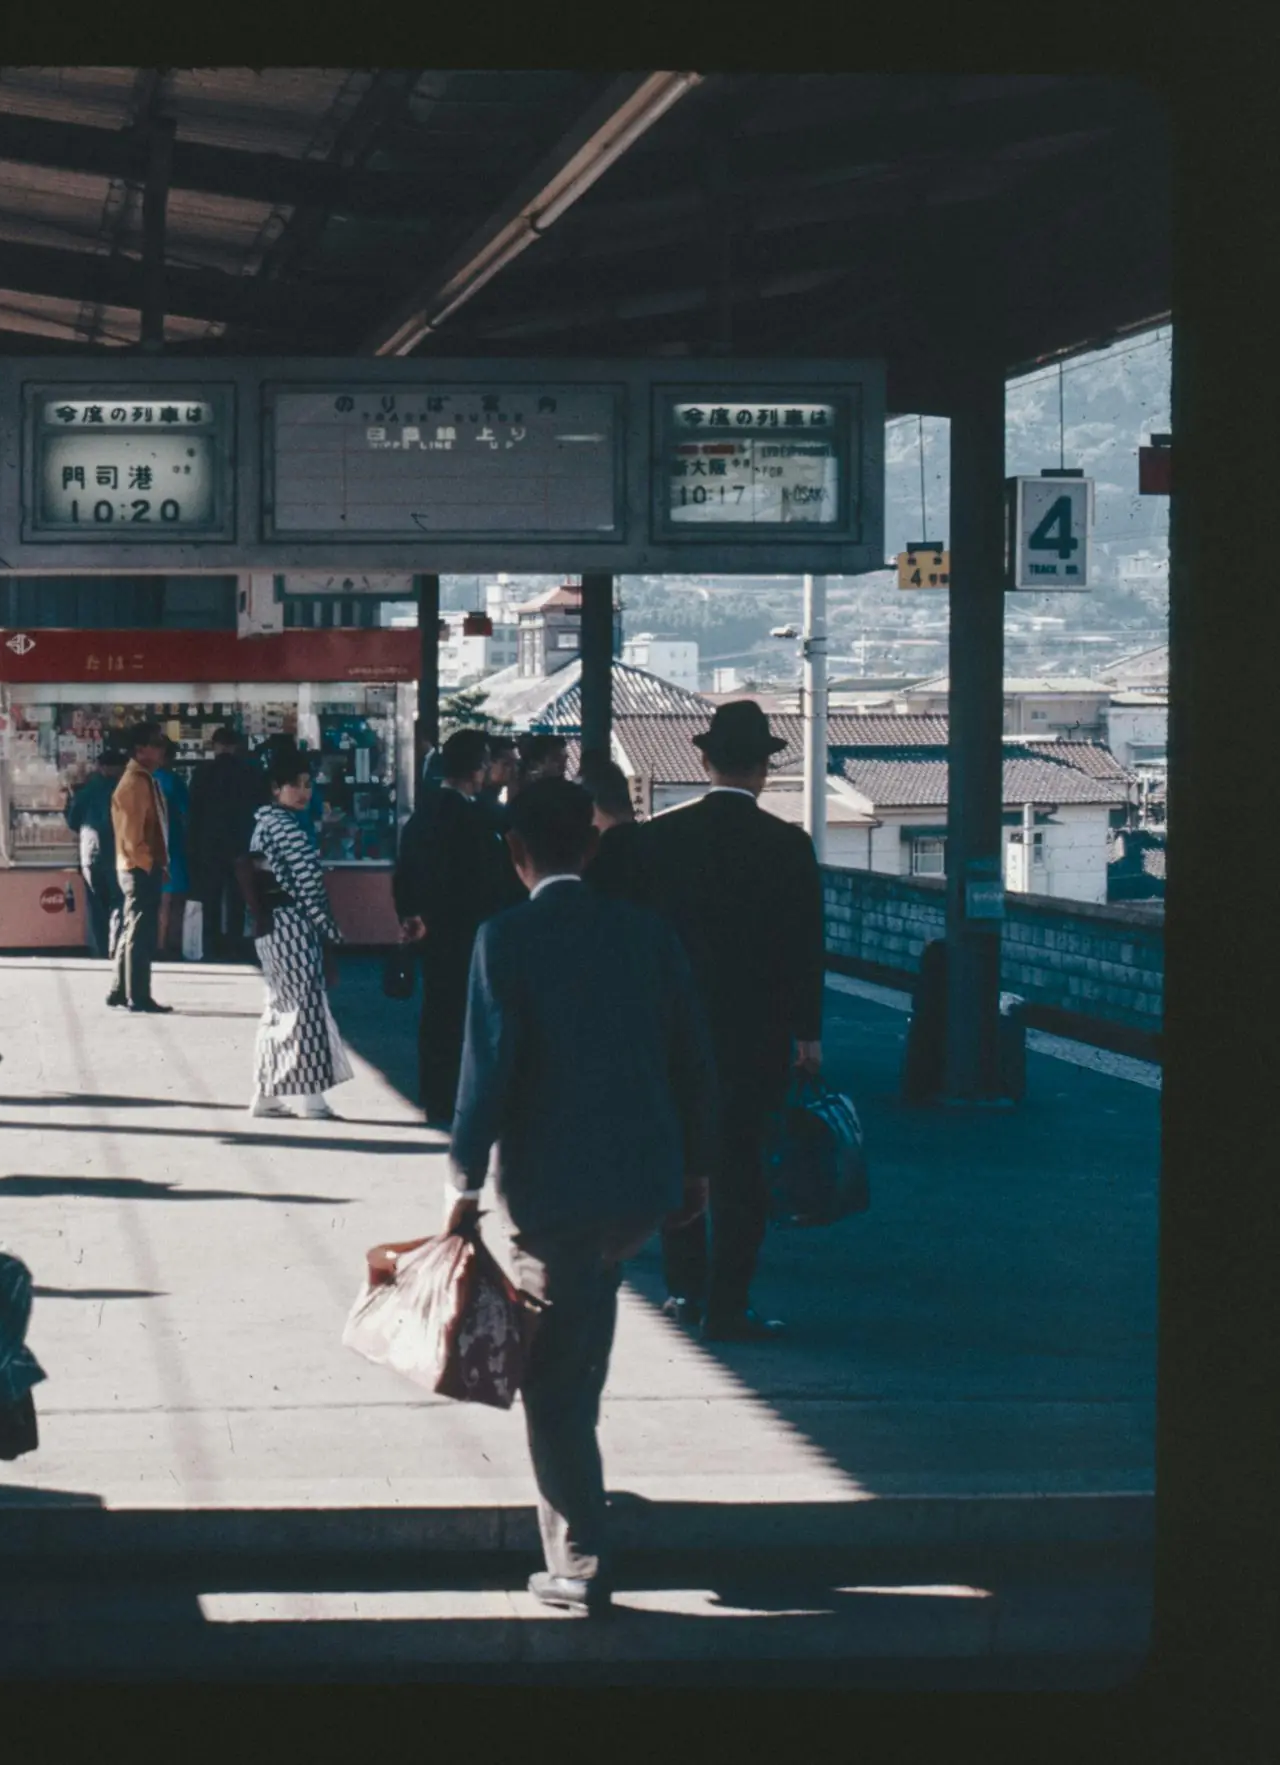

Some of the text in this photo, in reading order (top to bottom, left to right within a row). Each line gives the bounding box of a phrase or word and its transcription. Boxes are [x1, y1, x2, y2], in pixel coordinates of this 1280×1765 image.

[55, 405, 203, 423] 今度の列車は
[334, 394, 557, 414] のりば案内
[683, 407, 828, 427] 今度の列車は
[672, 458, 727, 477] 新大阪
[61, 465, 154, 491] 門司港
[679, 484, 746, 506] 10:17
[70, 499, 181, 523] 10:20
[1028, 494, 1079, 560] 4
[911, 568, 922, 588] 4
